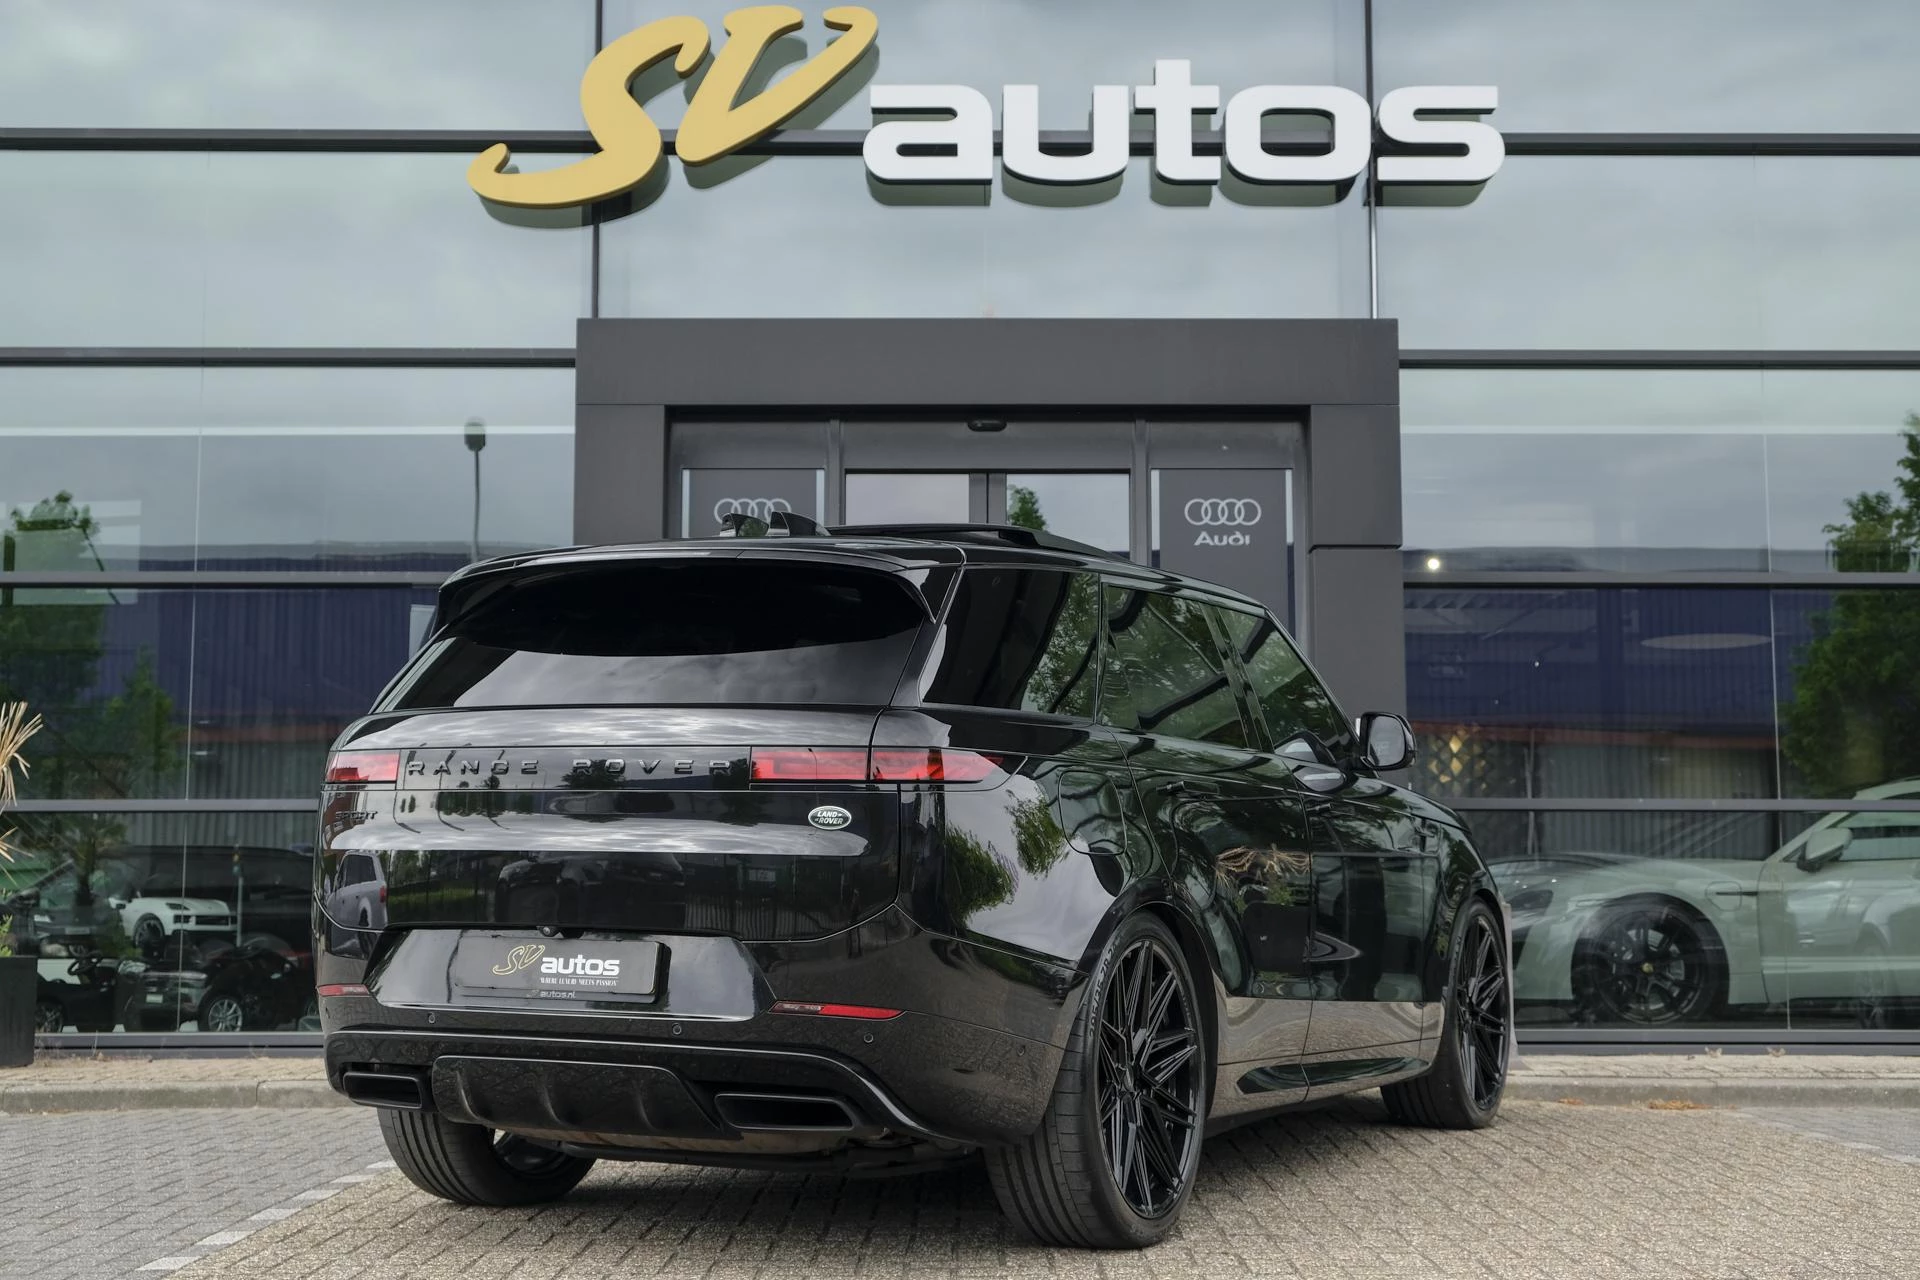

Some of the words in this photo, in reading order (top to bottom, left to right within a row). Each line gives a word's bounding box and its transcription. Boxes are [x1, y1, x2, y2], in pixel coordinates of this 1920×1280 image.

[467, 6, 878, 207] SV
[863, 59, 1506, 187] autos
[1194, 531, 1251, 546] Audi
[406, 759, 540, 776] RANGE
[572, 757, 732, 776] ROVER
[335, 810, 378, 821] SPORT
[492, 944, 546, 976] SV
[540, 954, 620, 976] autos
